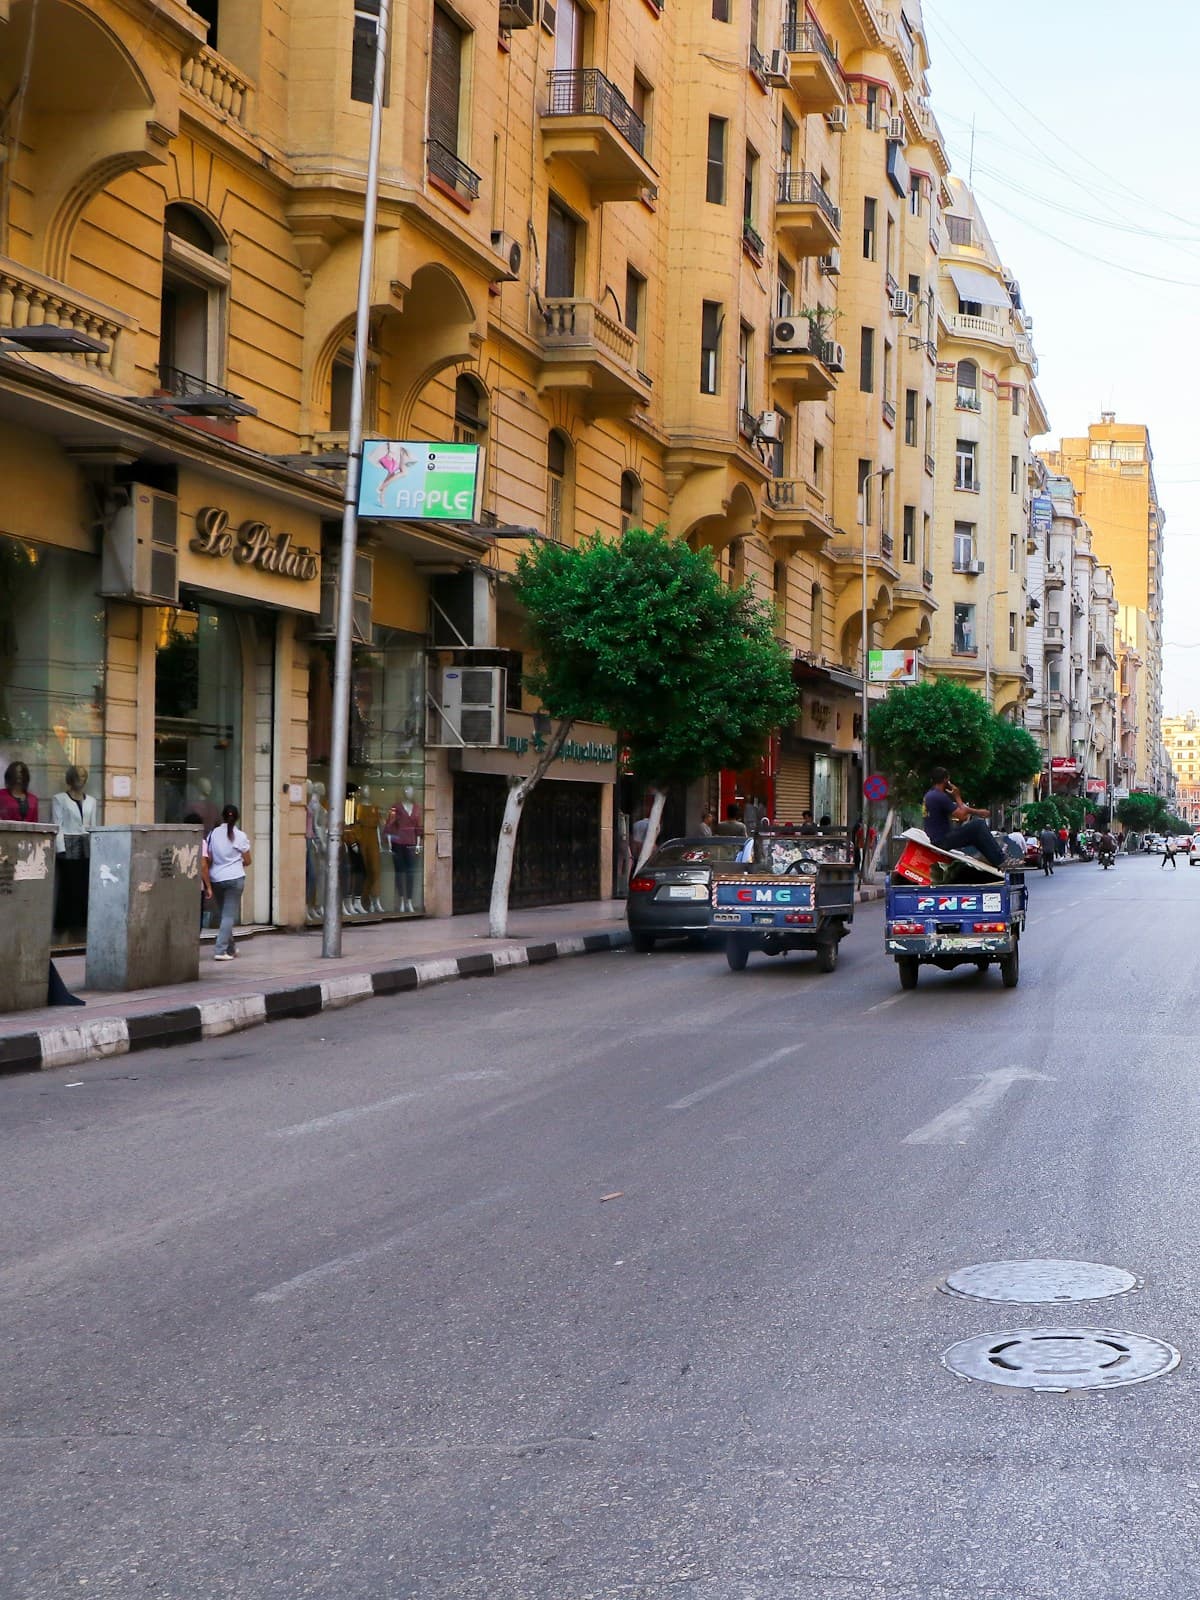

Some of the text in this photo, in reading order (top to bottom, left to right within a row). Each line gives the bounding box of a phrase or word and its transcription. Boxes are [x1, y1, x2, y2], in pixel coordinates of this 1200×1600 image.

[396, 489, 471, 511] APPLE
[189, 507, 318, 580] Le Palais
[737, 889, 791, 902] CMG
